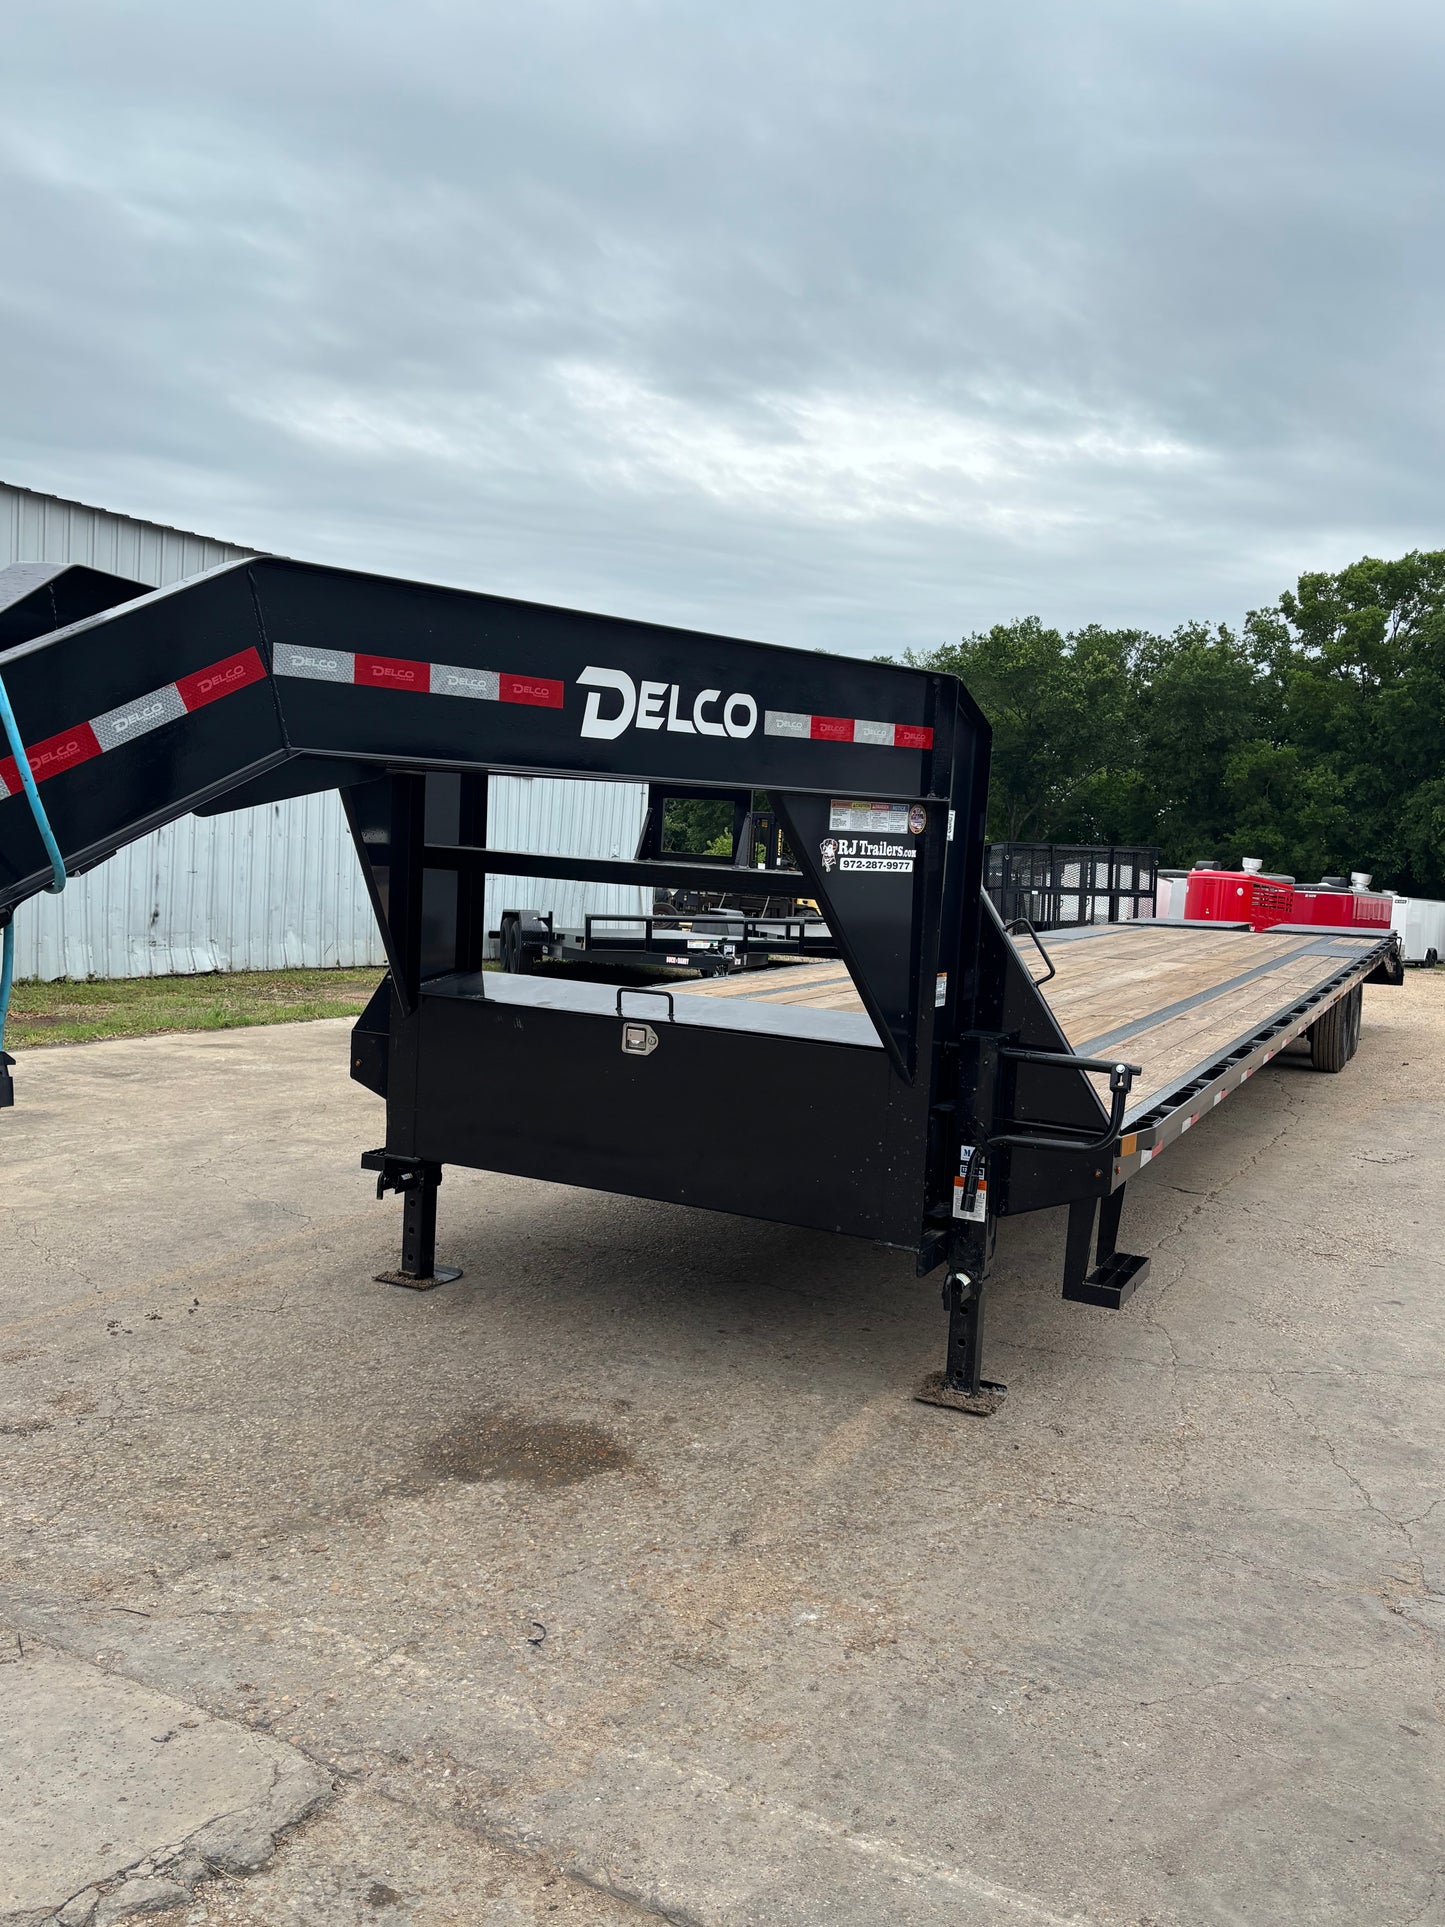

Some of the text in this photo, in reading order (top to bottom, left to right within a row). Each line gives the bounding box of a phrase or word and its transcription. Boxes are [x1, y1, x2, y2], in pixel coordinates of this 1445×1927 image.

[290, 655, 337, 669] DELCO
[371, 665, 415, 678] DELCO
[197, 665, 244, 693] DELCO
[446, 675, 487, 687] DELCO
[512, 683, 549, 696] DELCO
[575, 665, 758, 740] DELCO
[111, 703, 163, 732] DELCO
[775, 719, 803, 729] DELCO
[820, 723, 845, 732] DELCO
[863, 727, 887, 737] DELCO
[903, 732, 926, 740] DELCO
[28, 741, 78, 771] DELCO
[837, 839, 858, 855] RJ
[843, 860, 910, 870] 972-287-9977
